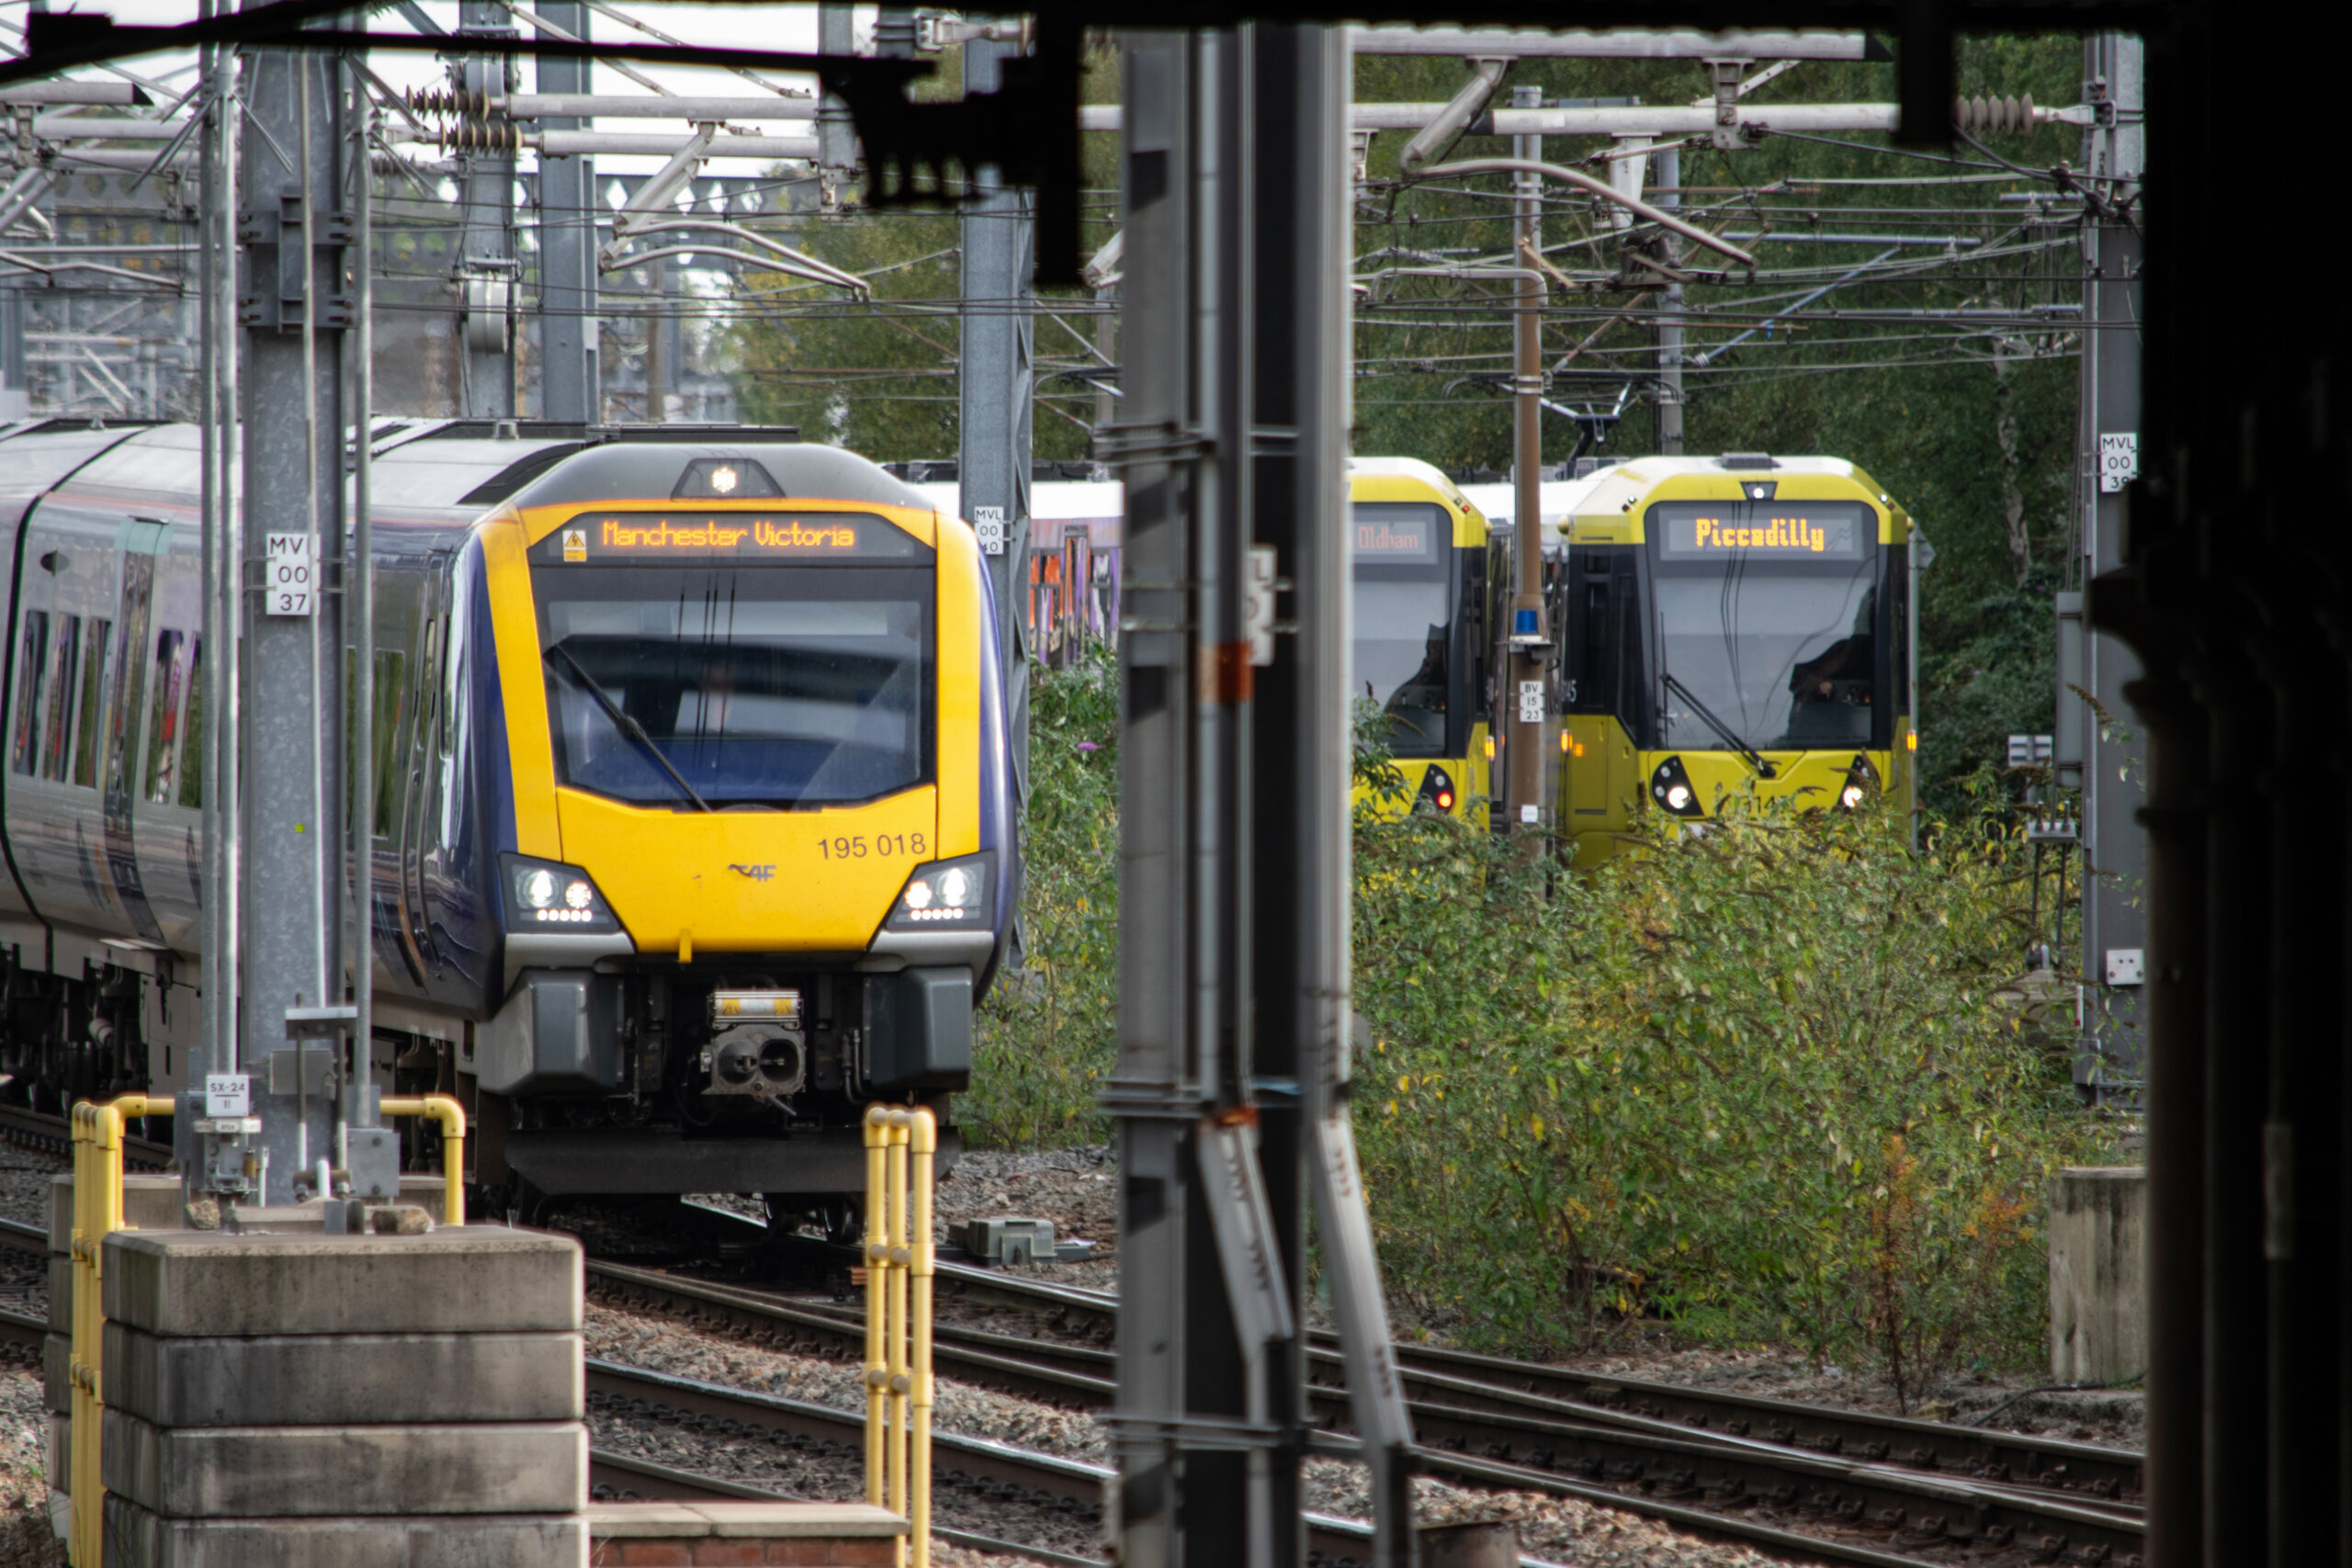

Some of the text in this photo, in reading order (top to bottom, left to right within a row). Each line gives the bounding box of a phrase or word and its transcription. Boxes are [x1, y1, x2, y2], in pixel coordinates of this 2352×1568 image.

[2102, 436, 2134, 449] MVL
[2109, 456, 2131, 469] 00
[976, 510, 1001, 520] MVL
[602, 520, 854, 546] Manchester Victoria
[979, 525, 999, 536] 00
[1357, 525, 1419, 549] Oldham
[1695, 518, 1825, 552] Piccadilly
[277, 565, 309, 583] 00
[279, 593, 307, 611] 37
[1525, 683, 1538, 693] BV
[1527, 697, 1537, 706] 15
[1526, 711, 1540, 720] 23
[817, 832, 927, 861] 195 018
[209, 1082, 246, 1092] SX-24
